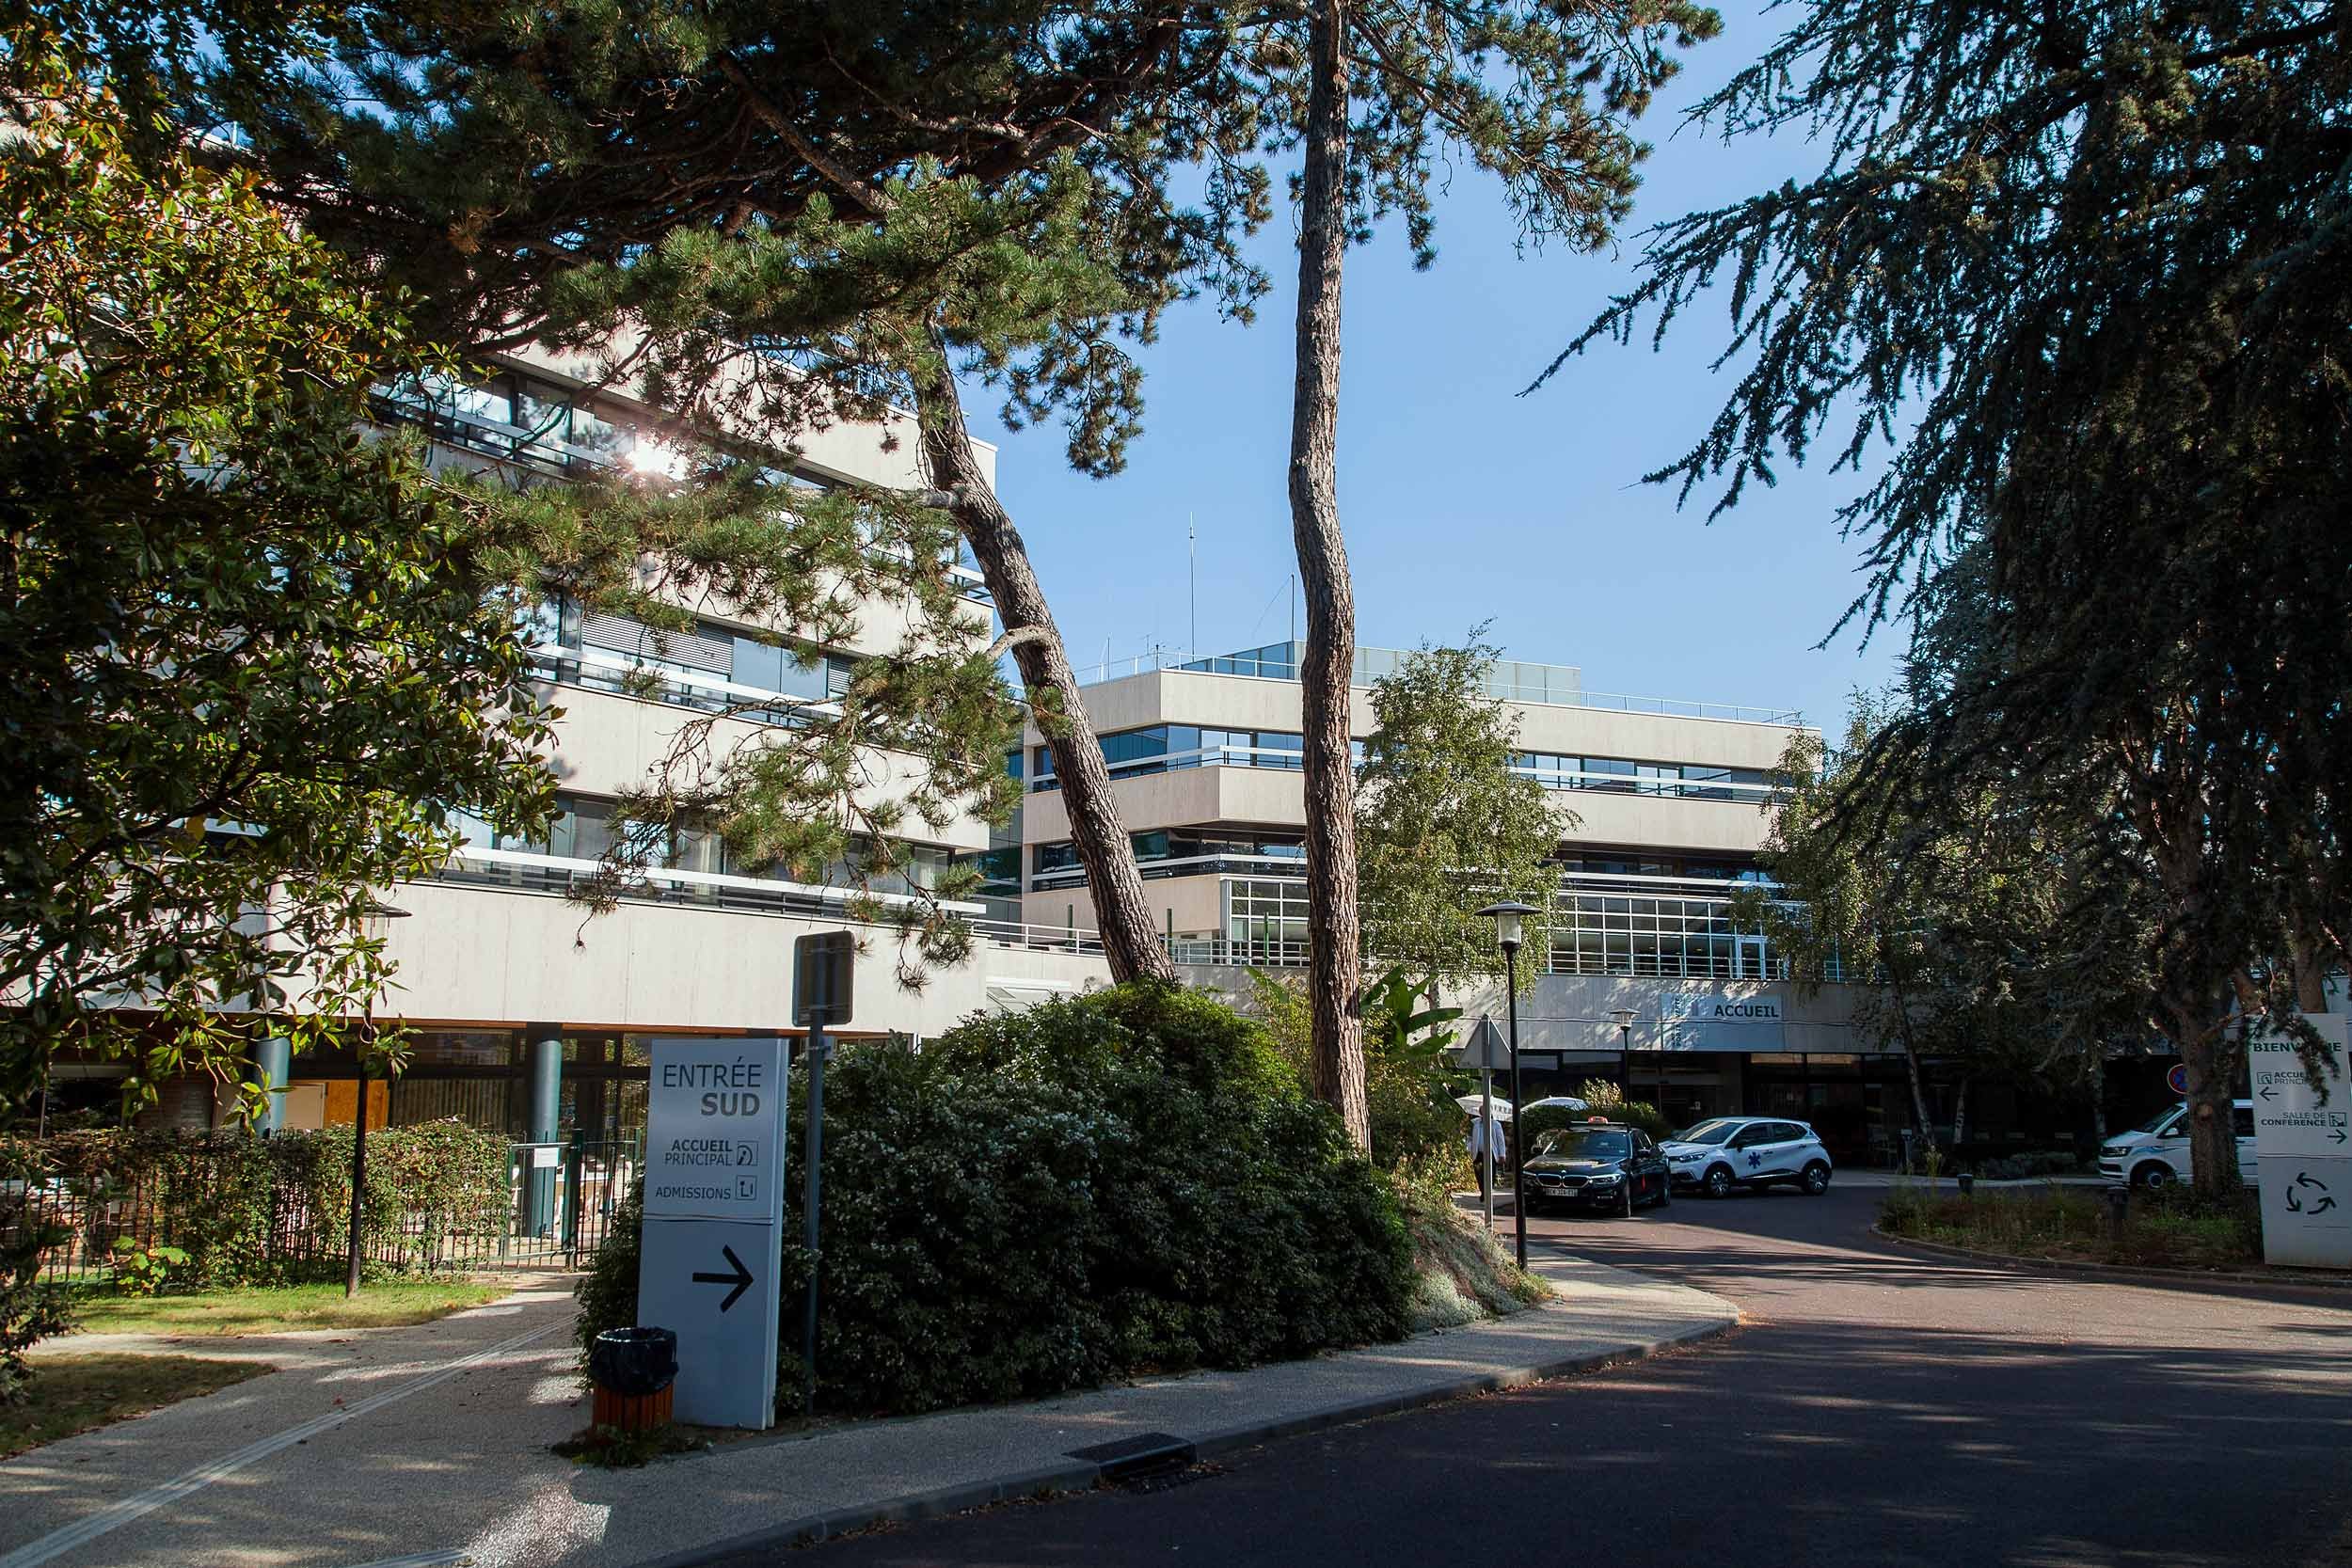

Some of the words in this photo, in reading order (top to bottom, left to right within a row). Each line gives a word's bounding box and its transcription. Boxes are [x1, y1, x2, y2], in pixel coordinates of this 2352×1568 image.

[1714, 1005, 1779, 1018] ACCUEIL
[2253, 1042, 2341, 1052] BIENVE
[663, 1056, 762, 1087] ENTRÉE
[701, 1093, 760, 1117] SUD
[672, 1139, 733, 1152] ACCUEIL
[664, 1151, 732, 1166] PRINCIPAL
[655, 1186, 731, 1199] ADMISSIONS
